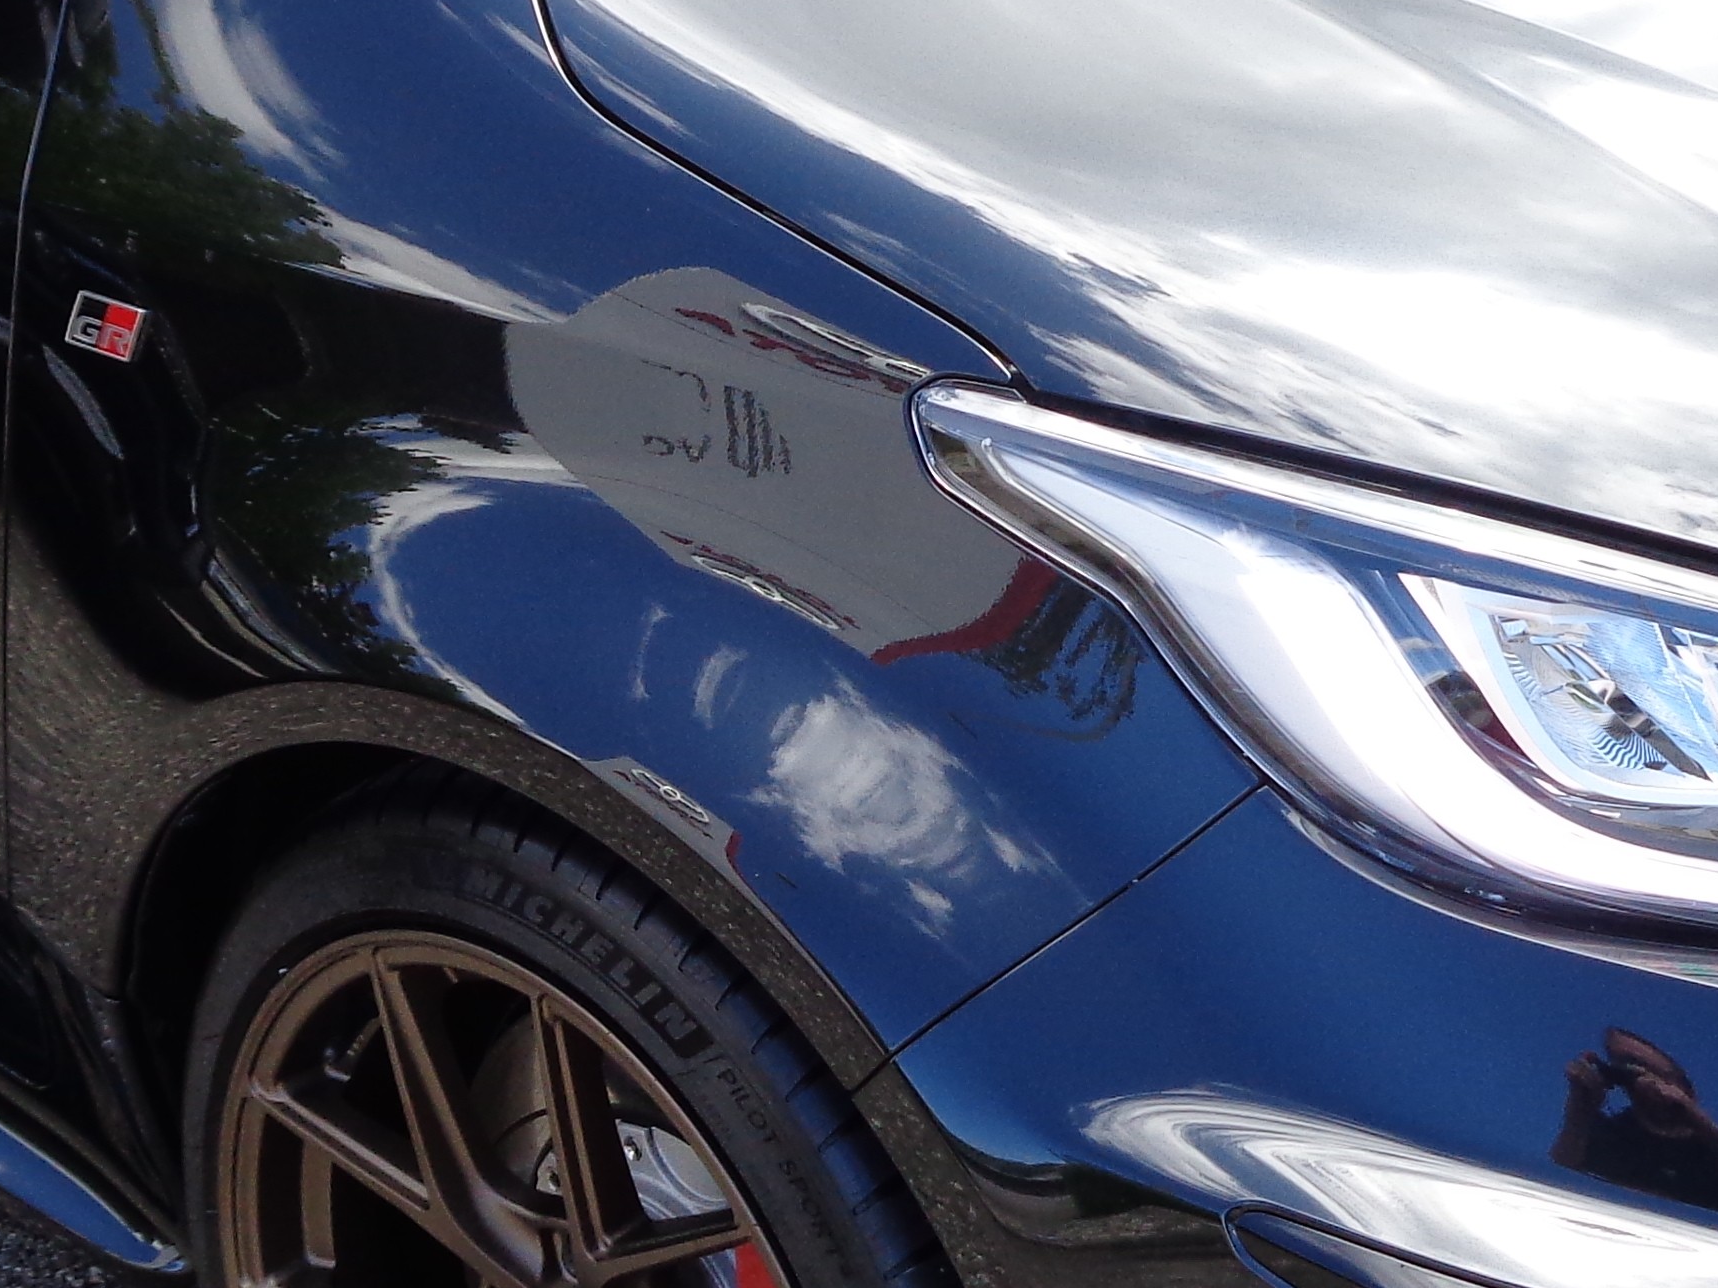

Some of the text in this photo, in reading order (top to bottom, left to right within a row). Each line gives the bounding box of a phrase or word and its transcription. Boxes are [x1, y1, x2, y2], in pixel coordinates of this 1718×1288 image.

[72, 315, 134, 356] GR
[463, 867, 699, 1042] MICHELIN
[716, 1066, 781, 1144] PILOT
